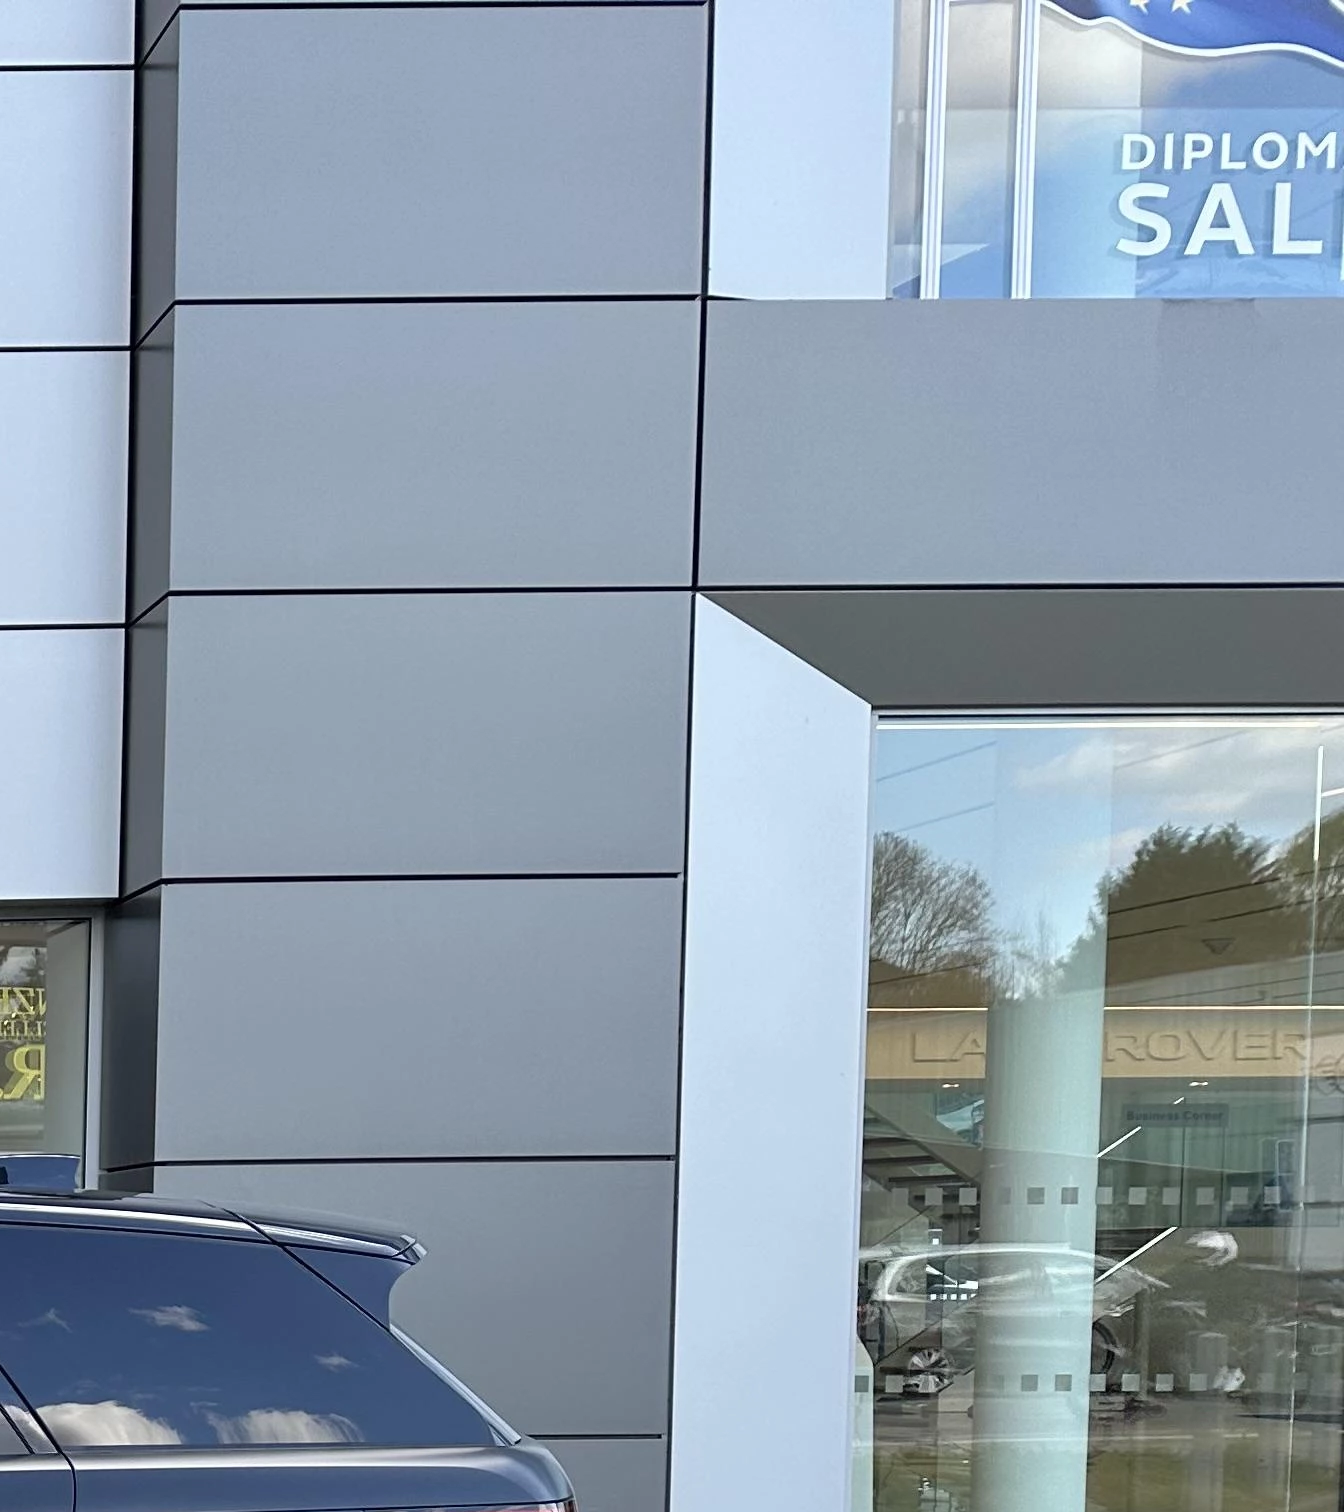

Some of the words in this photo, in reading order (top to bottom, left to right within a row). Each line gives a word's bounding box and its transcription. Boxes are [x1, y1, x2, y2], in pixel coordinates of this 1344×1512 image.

[1120, 131, 1344, 170] DIPLOM
[913, 1030, 985, 1063] LA
[1105, 1029, 1309, 1063] ROVER
